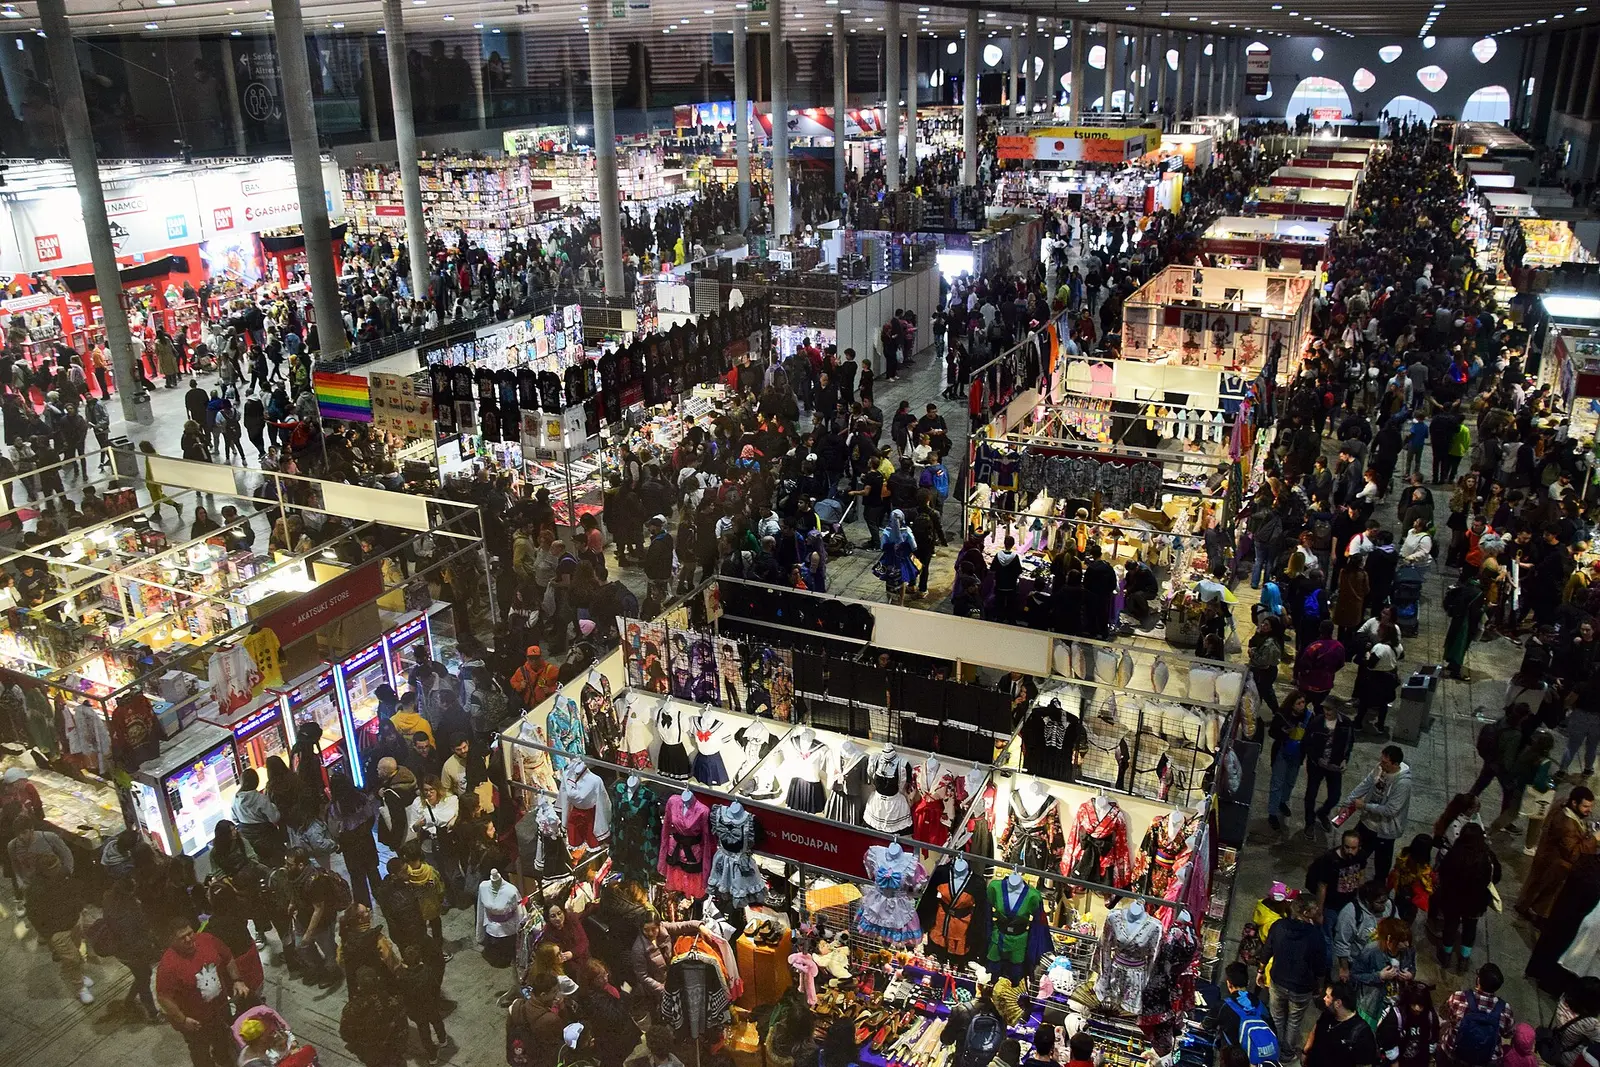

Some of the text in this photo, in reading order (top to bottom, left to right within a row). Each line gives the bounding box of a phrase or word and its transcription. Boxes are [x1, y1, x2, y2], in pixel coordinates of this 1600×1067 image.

[297, 589, 350, 624] AKATSUKI STORE
[781, 830, 838, 854] MODJAPAN
